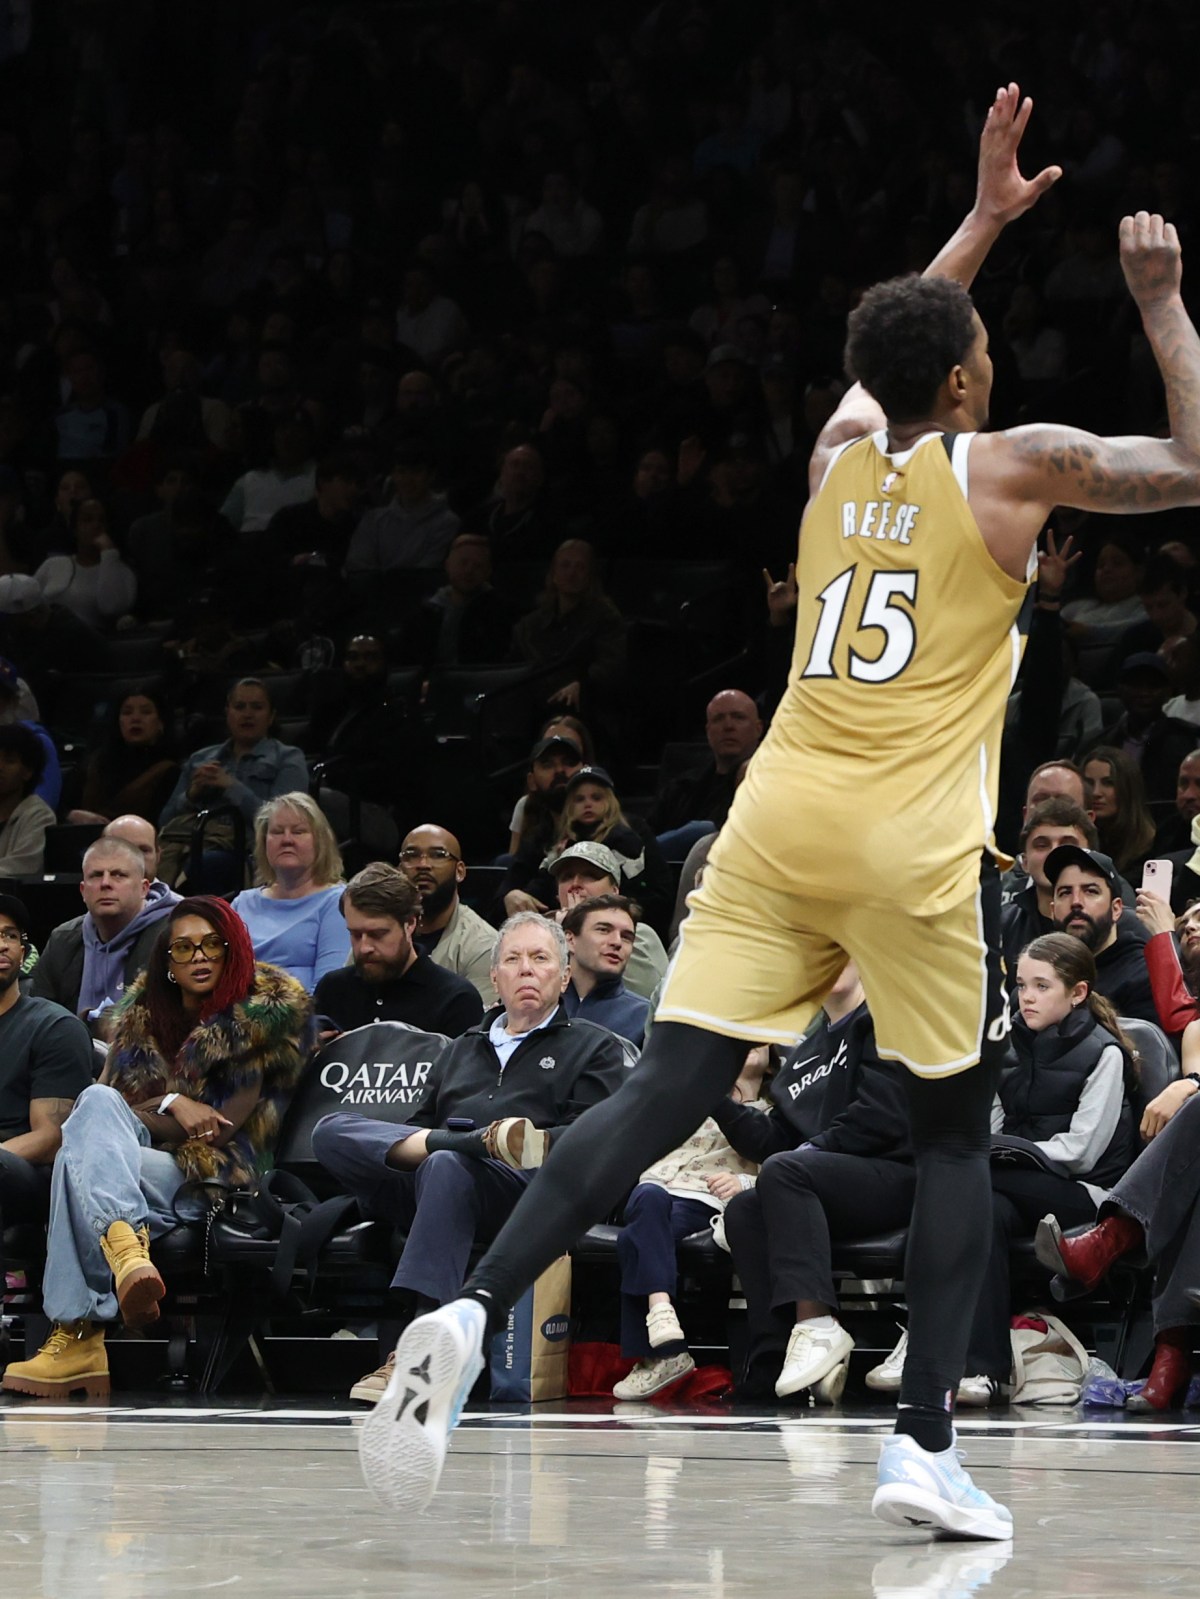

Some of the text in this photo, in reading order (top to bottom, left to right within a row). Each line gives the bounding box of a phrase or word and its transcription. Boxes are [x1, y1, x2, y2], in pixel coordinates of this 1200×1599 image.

[842, 501, 919, 544] REESE
[799, 562, 919, 684] 15
[320, 1062, 433, 1094] QATAR
[507, 1313, 515, 1331] the
[545, 1323, 556, 1336] OLD
[505, 1344, 514, 1370] fun's
